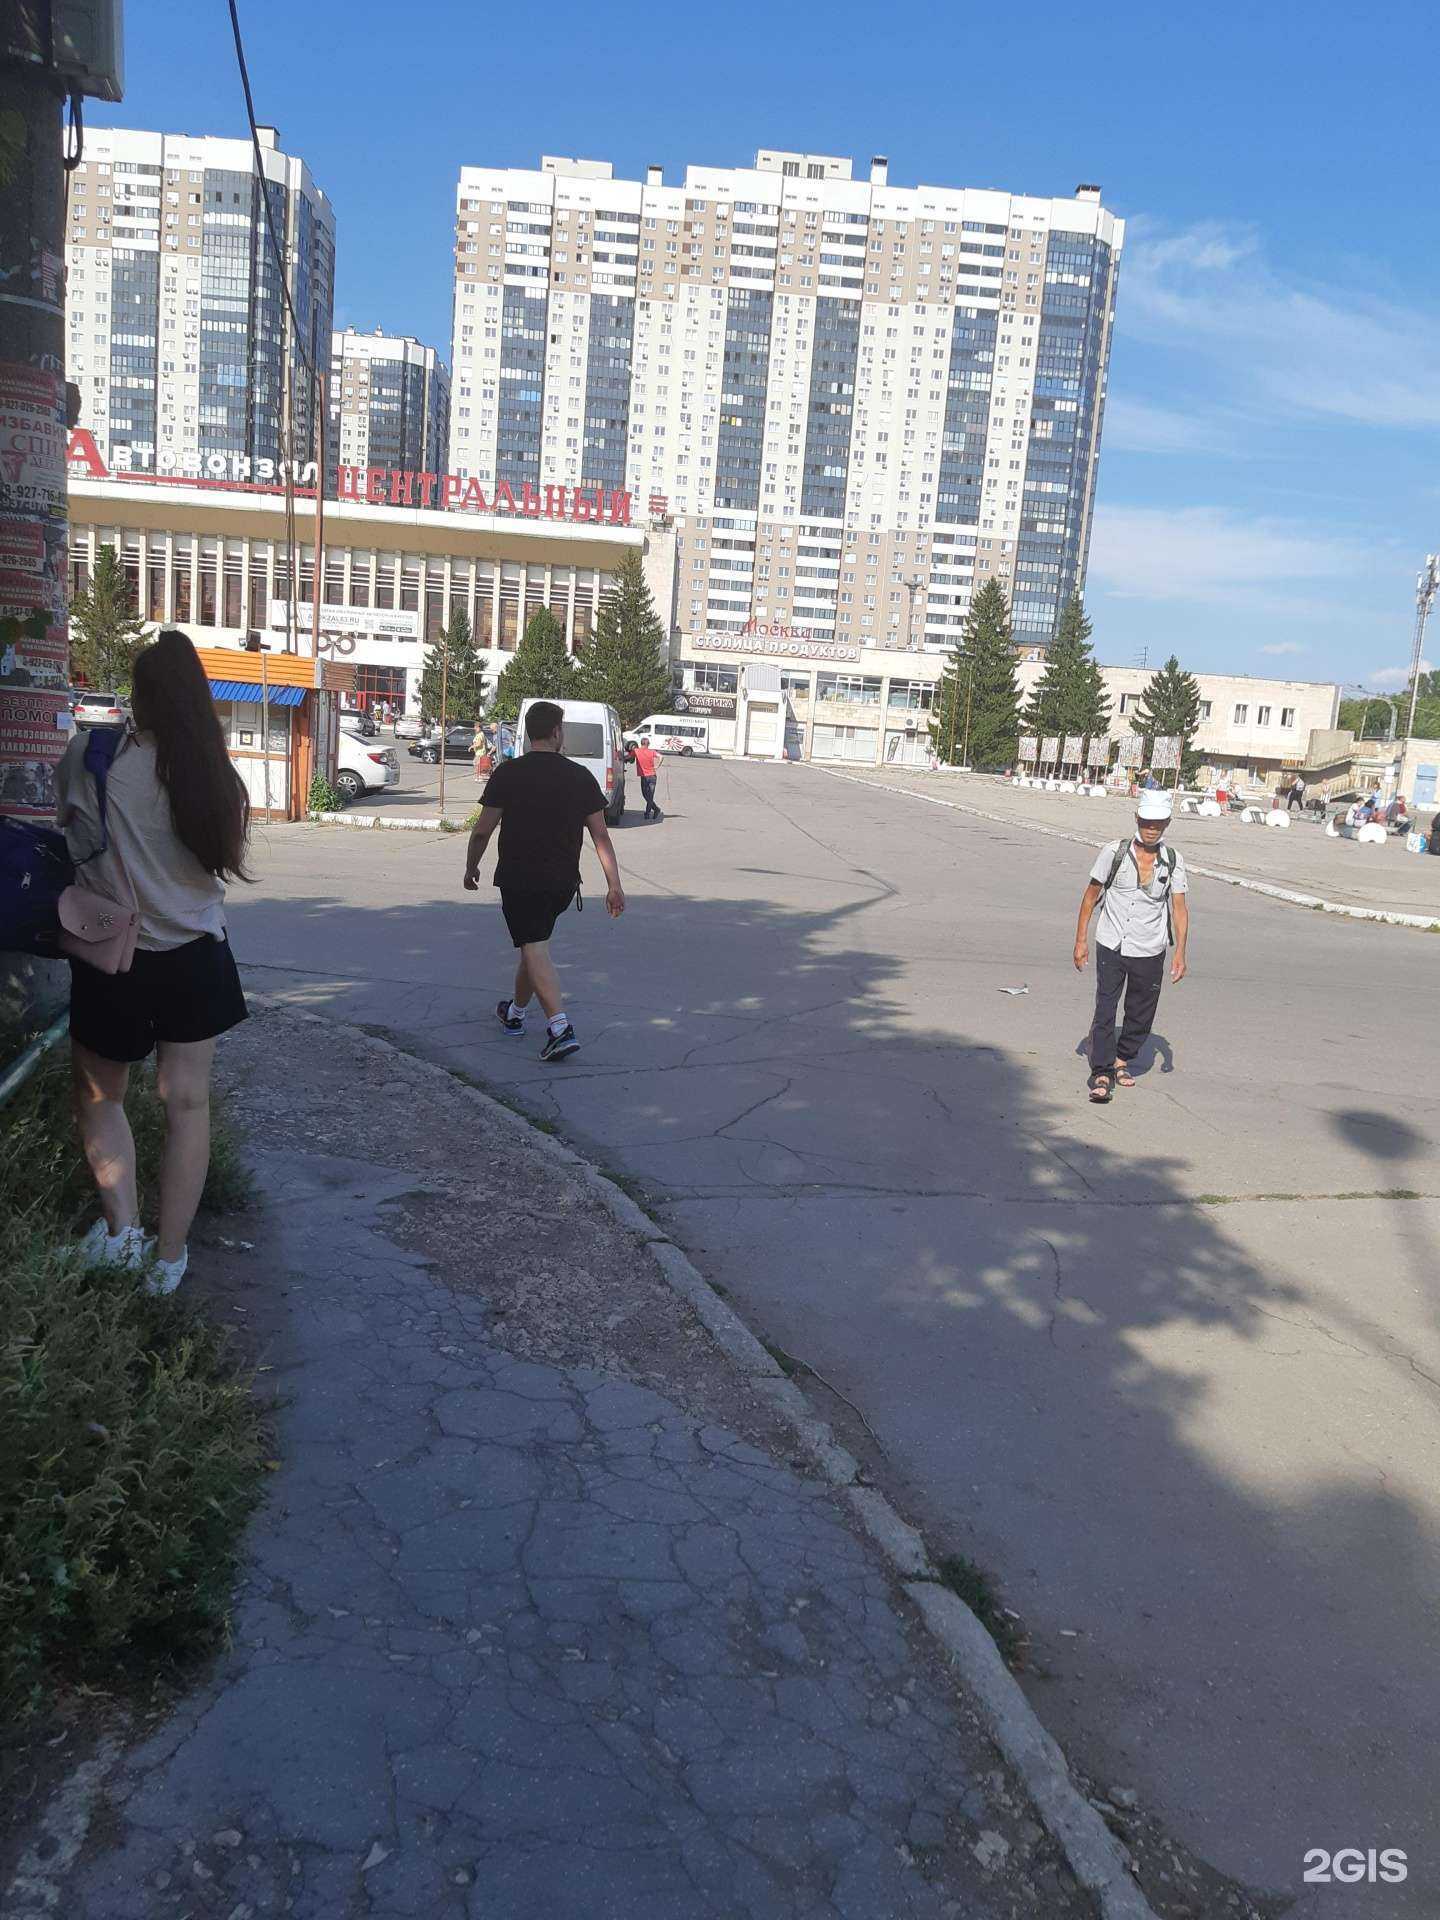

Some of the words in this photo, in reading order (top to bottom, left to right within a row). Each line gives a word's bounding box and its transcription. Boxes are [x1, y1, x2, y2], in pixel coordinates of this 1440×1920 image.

[337, 463, 632, 526] ЦЕНТРАЛЬНЫЙ
[696, 635, 765, 653] СТОЛИЦА
[768, 640, 858, 661] ПРОДУКТОВ
[689, 696, 735, 708] ФАБРИКА
